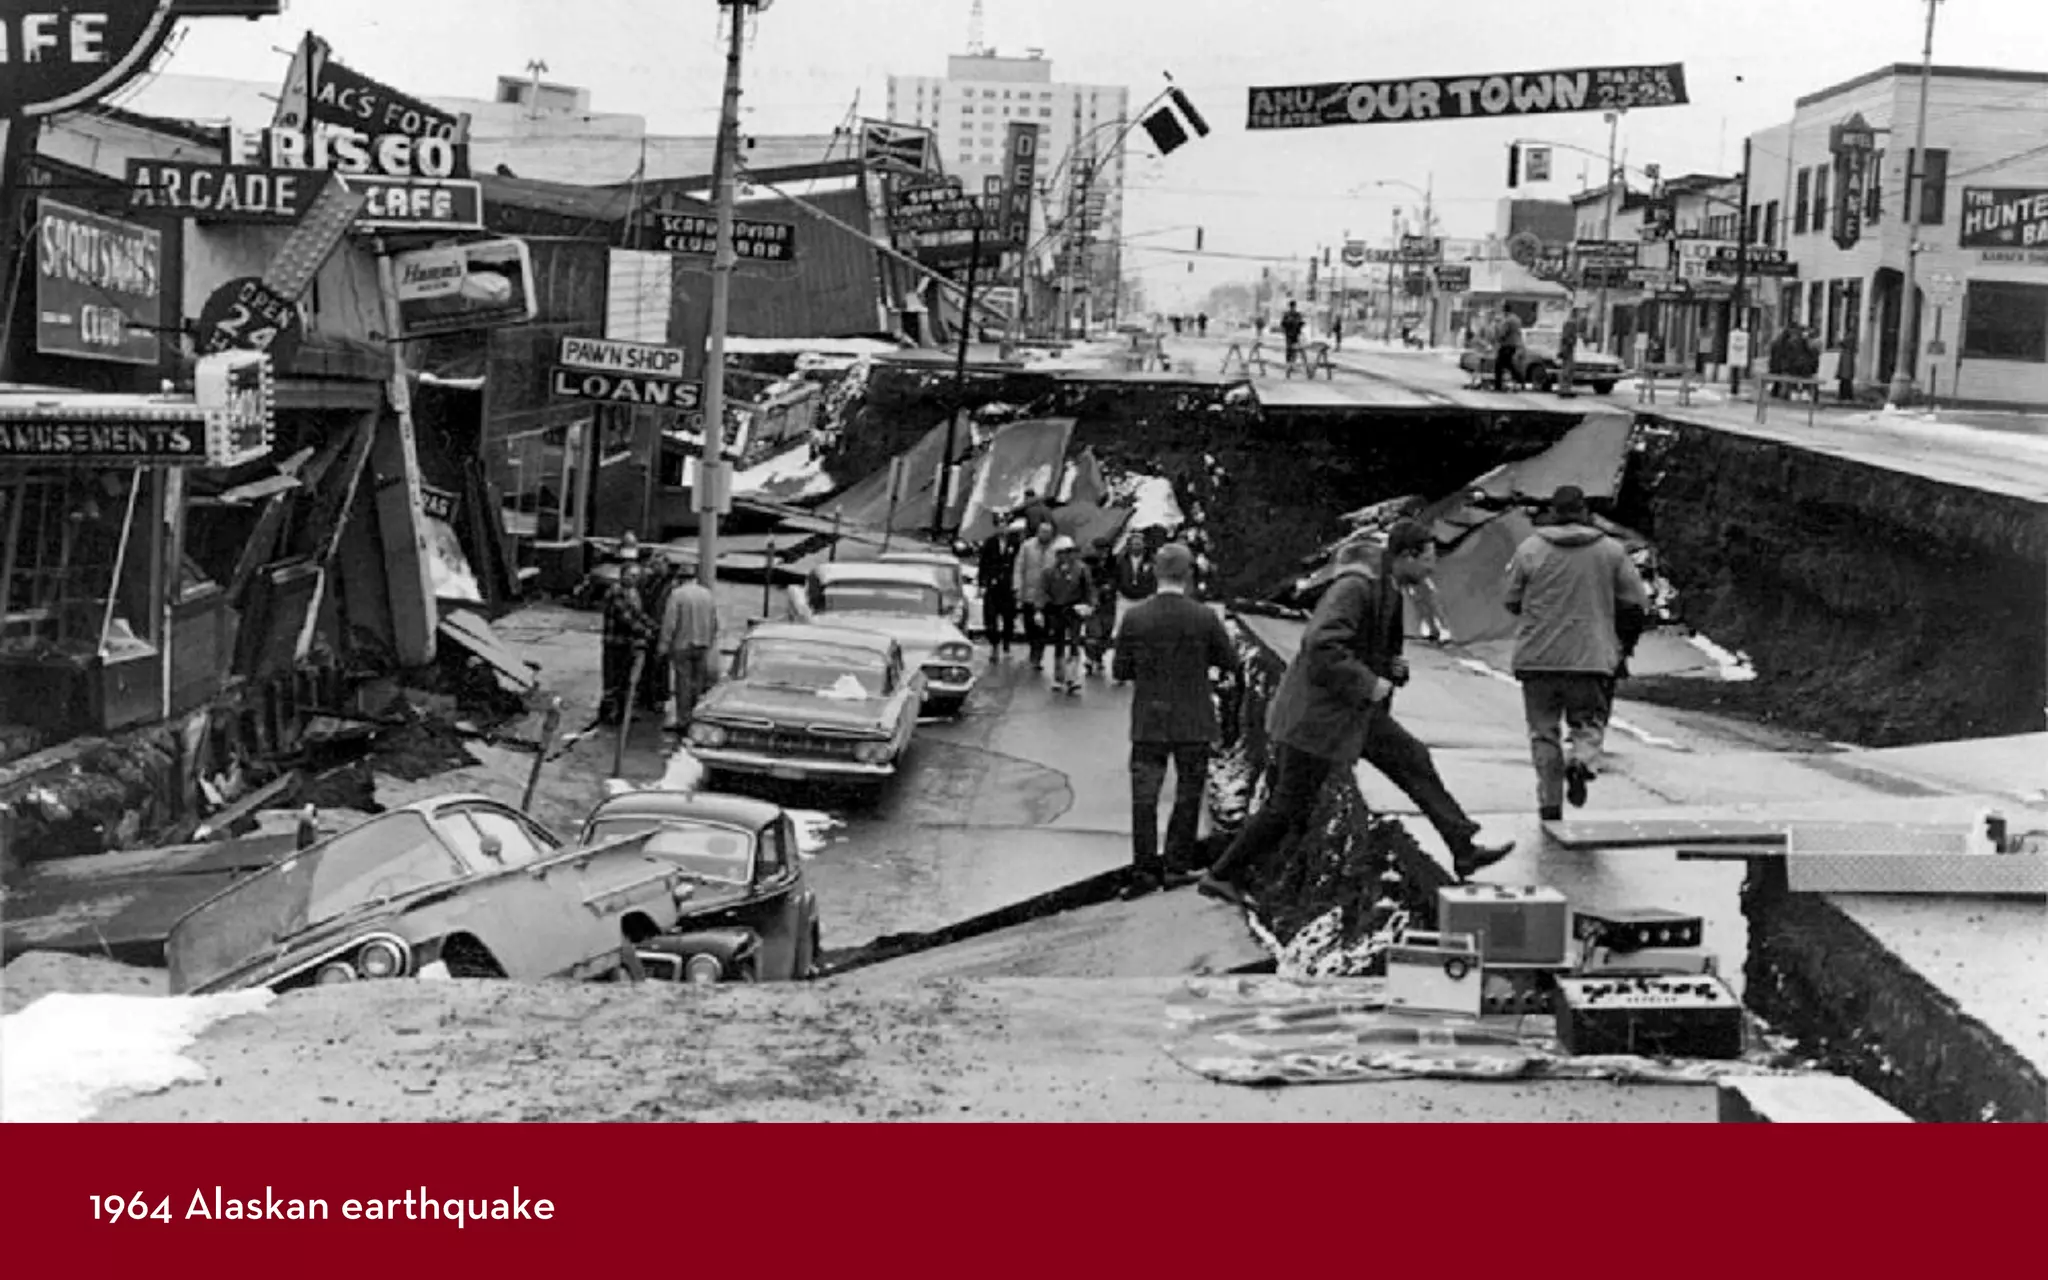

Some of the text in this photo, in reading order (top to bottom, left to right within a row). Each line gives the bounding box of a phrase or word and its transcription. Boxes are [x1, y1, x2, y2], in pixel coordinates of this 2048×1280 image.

[0, 13, 108, 63] FE
[317, 82, 376, 118] AC'S
[1347, 80, 1441, 122] OUR
[1447, 72, 1590, 116] TOWN
[130, 167, 298, 216] ARCADE
[365, 185, 453, 219] CAFE
[216, 302, 278, 352] 24
[567, 341, 681, 371] PAWN SHOP
[555, 372, 699, 406] LOANS
